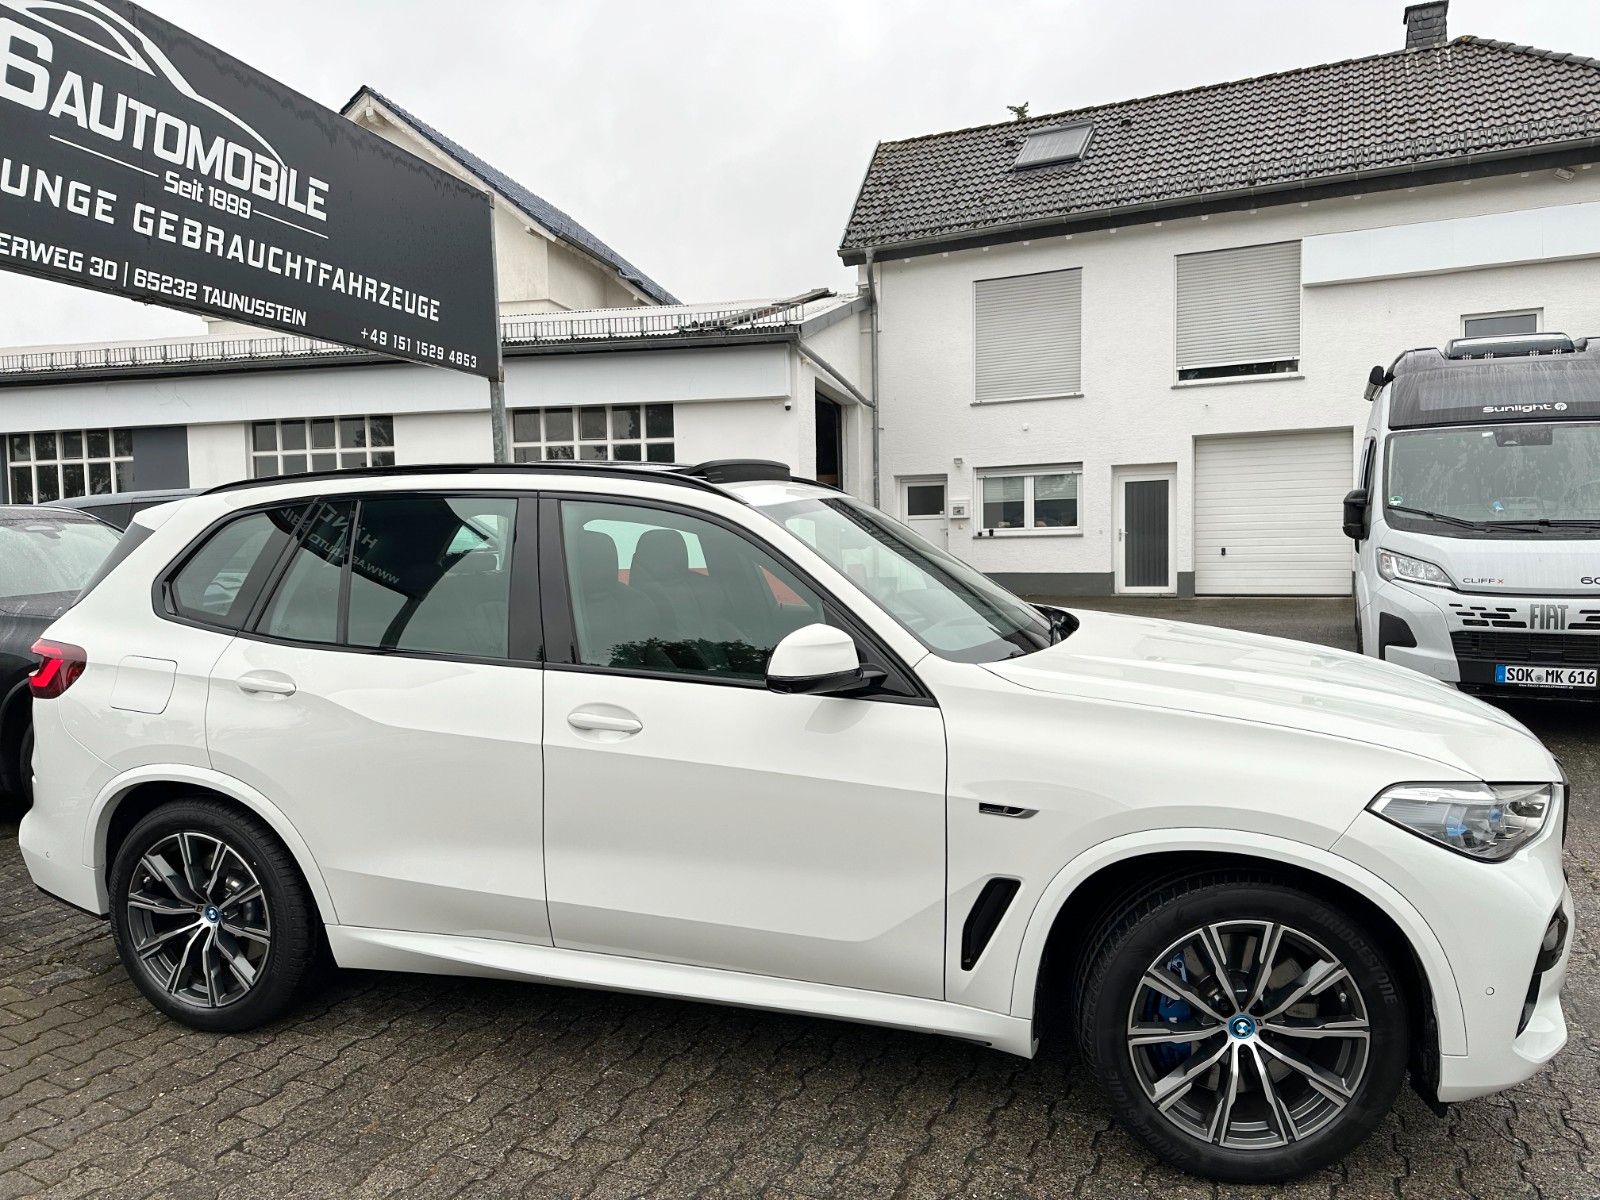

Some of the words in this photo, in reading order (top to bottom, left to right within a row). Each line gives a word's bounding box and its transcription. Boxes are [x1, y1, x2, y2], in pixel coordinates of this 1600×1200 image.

[164, 170, 205, 203] Seit
[208, 185, 251, 219] 1999
[0, 157, 117, 225] UNGE
[132, 202, 440, 322] GEBRAUCHTFAHRZEUGE
[0, 232, 84, 273] ERWEG
[89, 256, 118, 281] 30
[133, 267, 198, 301] 65232
[202, 285, 307, 327] TAUNUSSTEIN
[360, 327, 388, 346] +49
[393, 334, 412, 352] 151
[416, 340, 444, 360] 1529
[448, 350, 477, 369] 4853
[1482, 403, 1552, 413] Sunlight
[1529, 603, 1568, 630] FIAT
[1506, 667, 1535, 683] SOK
[1545, 669, 1564, 684] MK
[1567, 670, 1596, 685] 616
